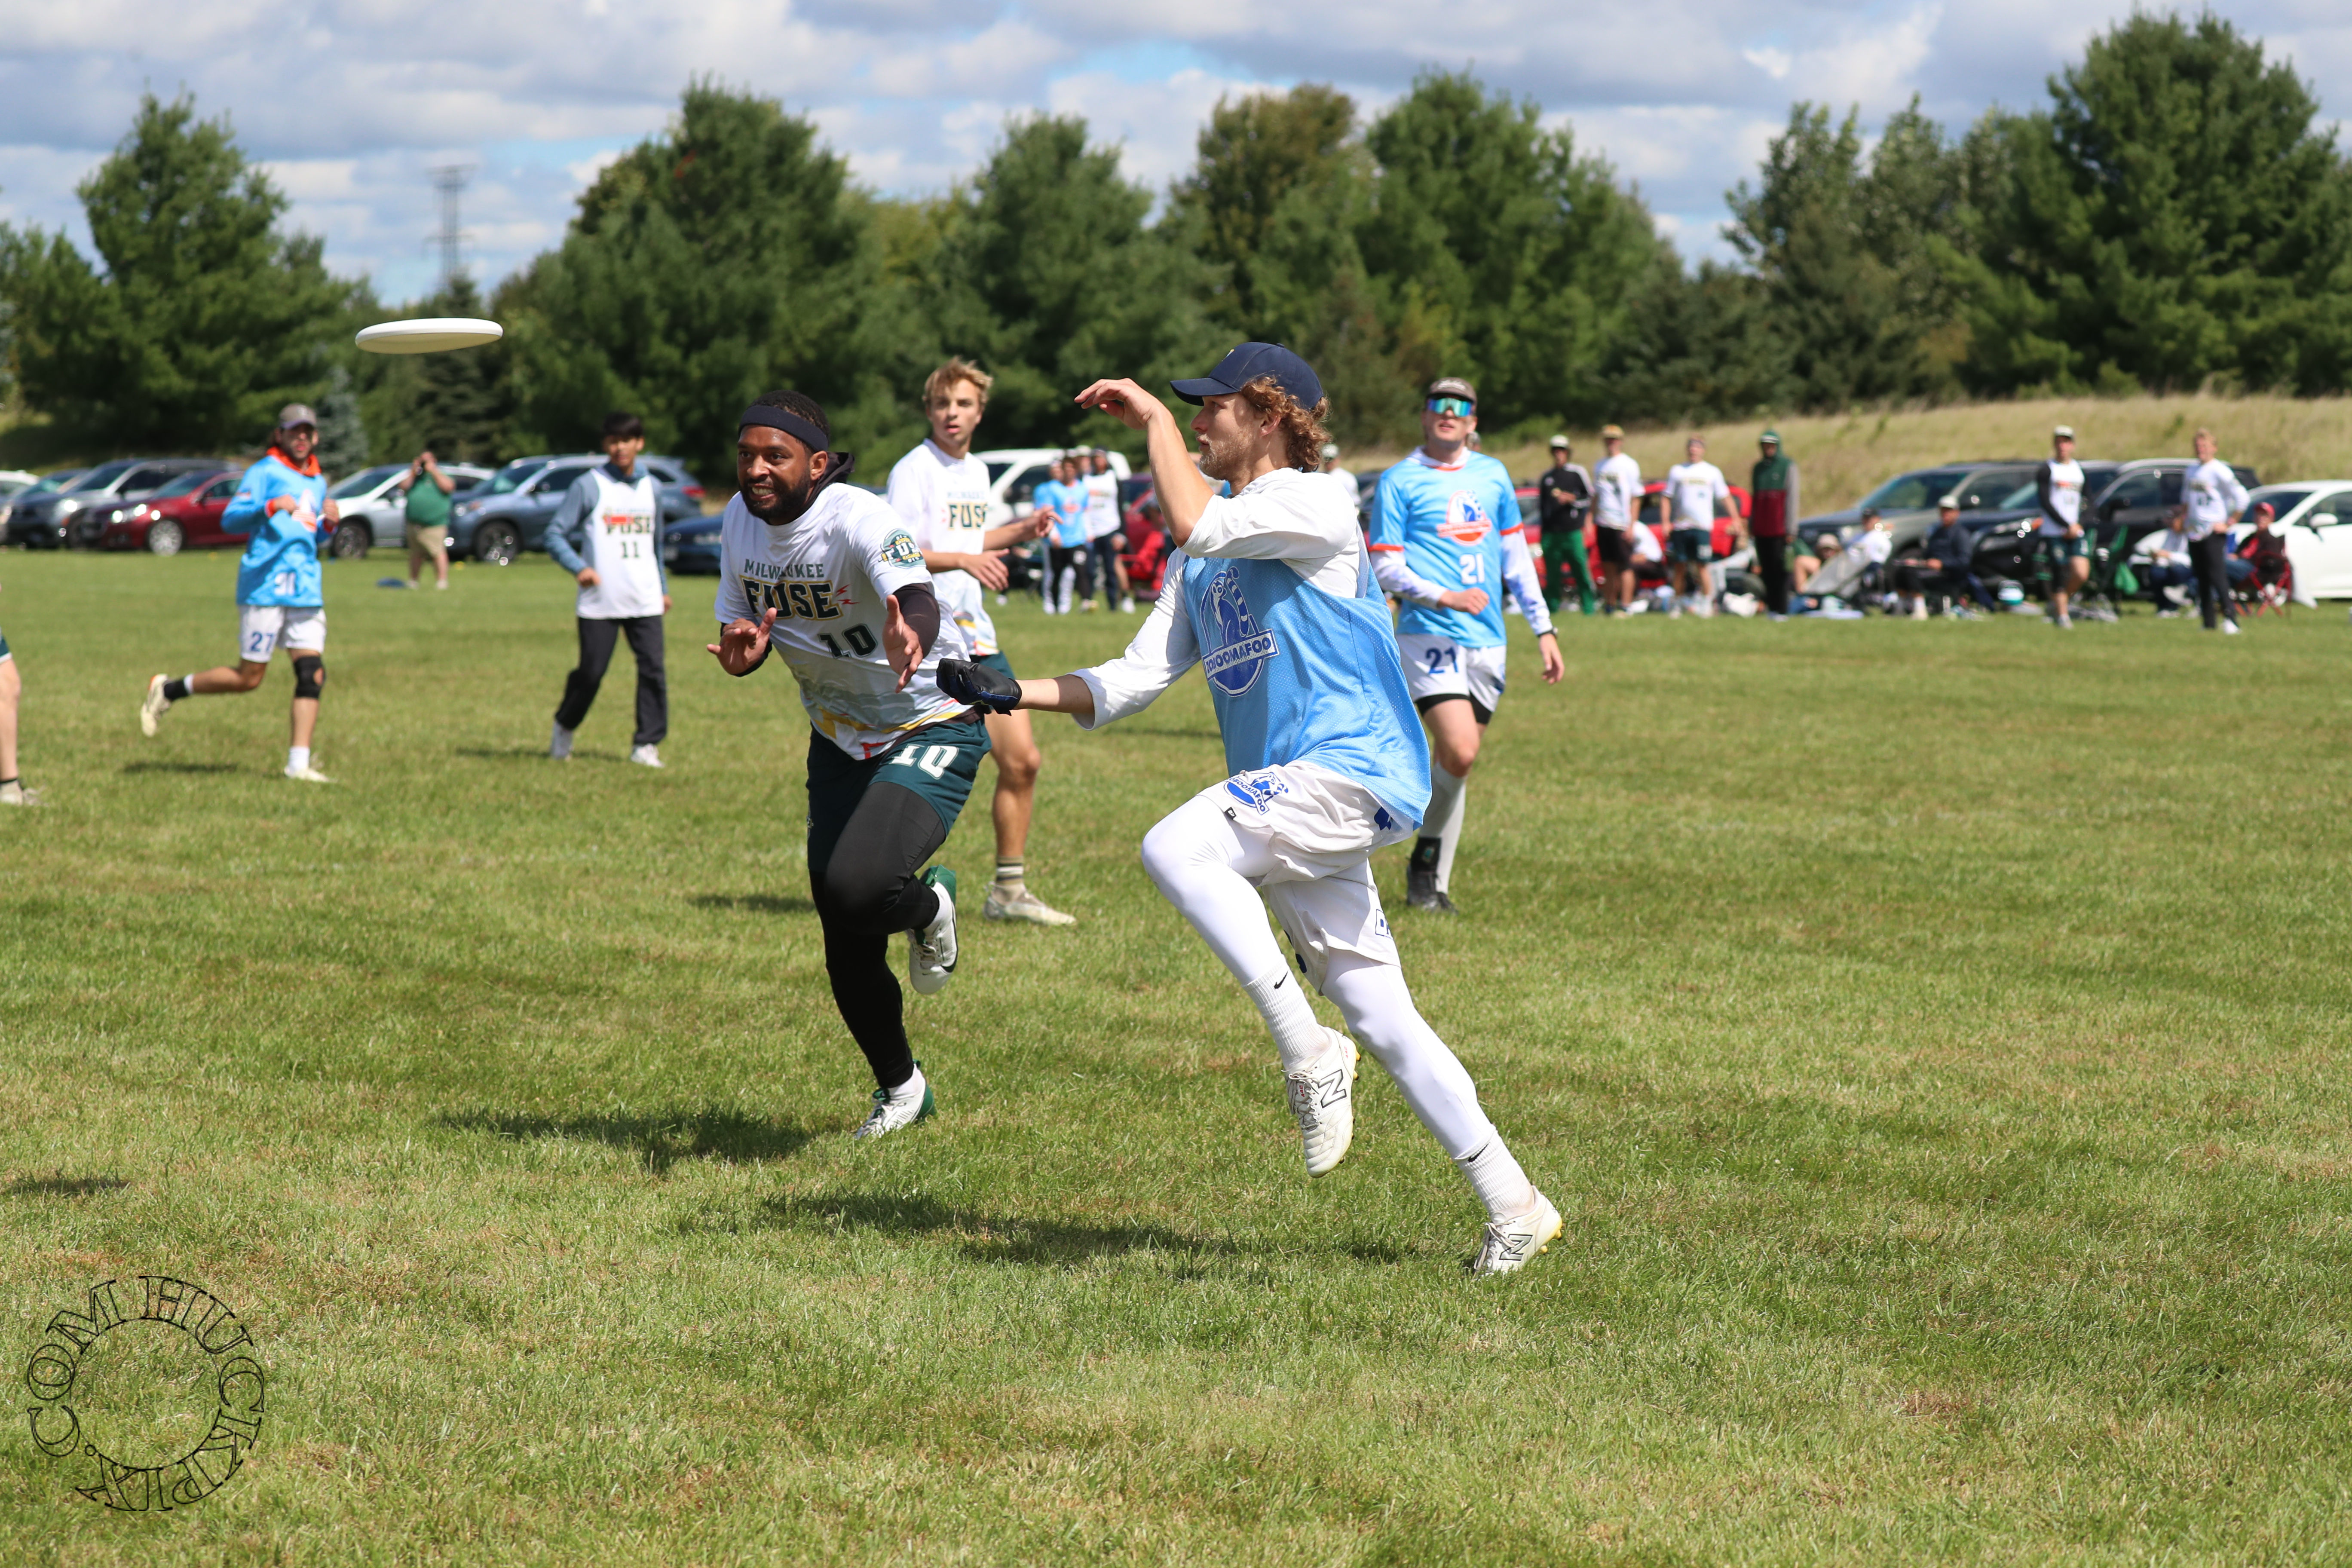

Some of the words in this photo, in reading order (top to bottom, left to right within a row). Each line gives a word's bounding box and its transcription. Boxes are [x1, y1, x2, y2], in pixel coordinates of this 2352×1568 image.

[621, 541, 640, 558] 11
[744, 559, 824, 579] MILWAUKEE
[1460, 553, 1485, 584] 21
[740, 576, 843, 620] FUSE
[251, 631, 273, 652] 27
[818, 624, 878, 659] 10
[1426, 646, 1458, 674] 21
[889, 744, 959, 780] 10
